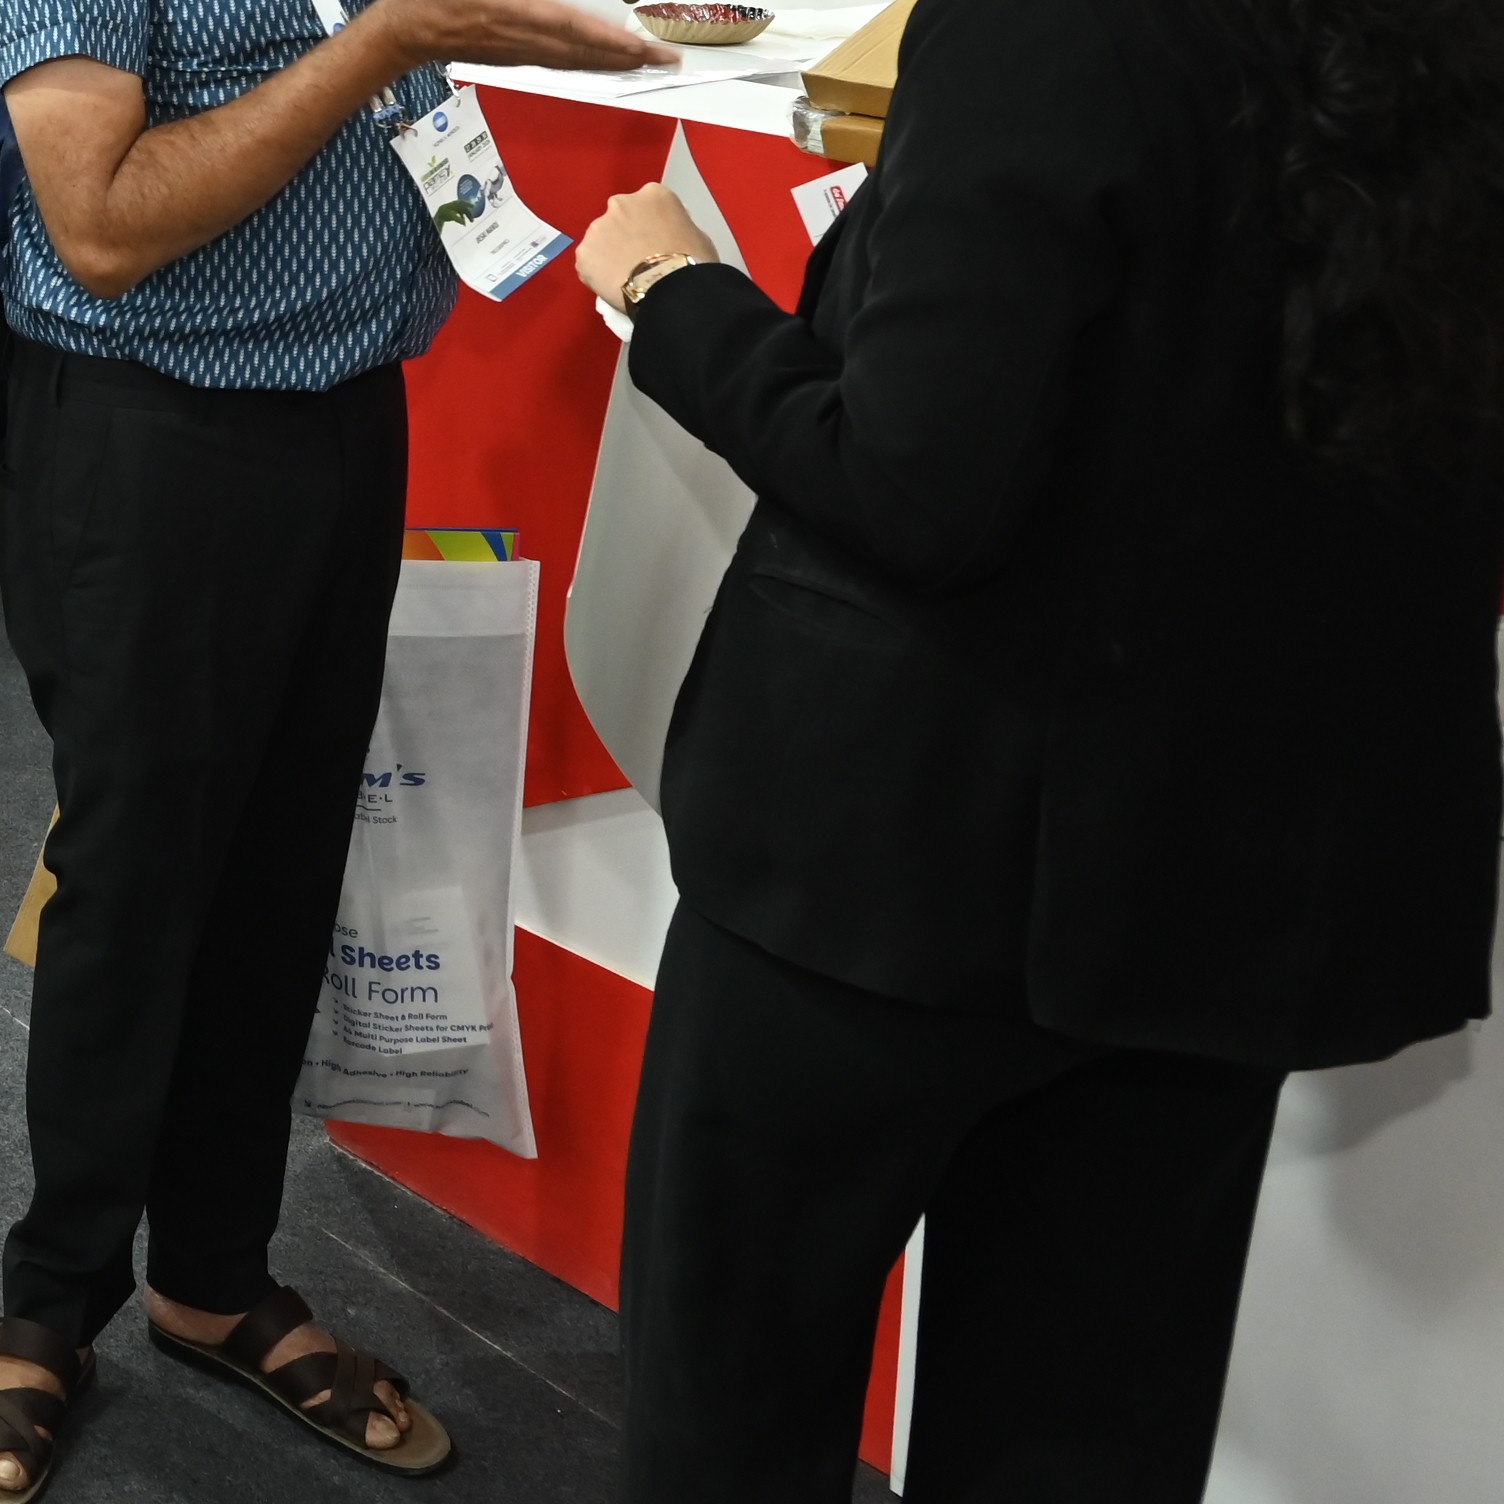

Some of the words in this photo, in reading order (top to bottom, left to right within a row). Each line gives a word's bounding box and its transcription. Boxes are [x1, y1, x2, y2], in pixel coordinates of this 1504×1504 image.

[516, 254, 548, 278] VISITOR
[372, 816, 398, 824] Stock
[341, 945, 441, 971] Sheets
[368, 980, 438, 1005] Form
[374, 1012, 399, 1021] Sheet
[373, 1023, 402, 1032] Sticker
[405, 1024, 434, 1032] Sheets
[436, 1024, 448, 1032] for
[354, 1030, 377, 1041] Multi
[379, 1034, 414, 1045] Purpose
[379, 1046, 402, 1055] Label
